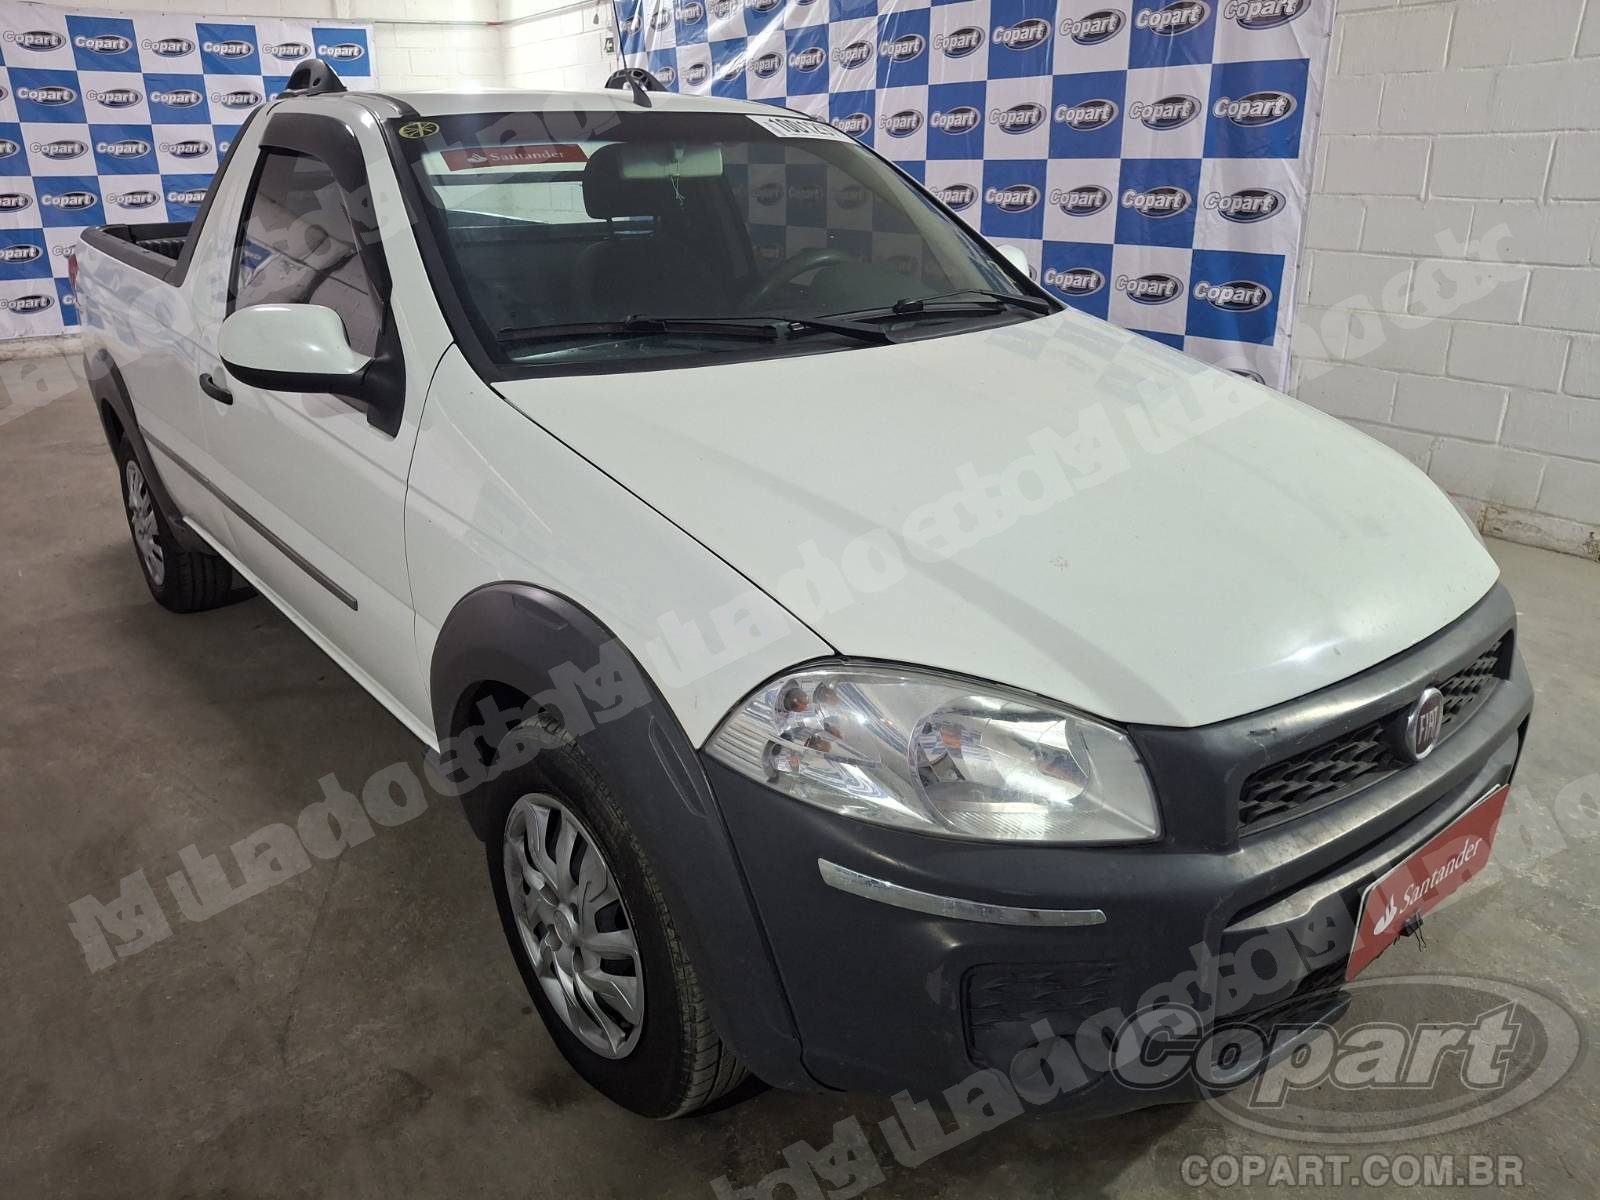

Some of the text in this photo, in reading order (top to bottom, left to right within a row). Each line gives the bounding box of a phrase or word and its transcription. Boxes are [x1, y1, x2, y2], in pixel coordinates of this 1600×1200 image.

[1136, 6, 1200, 31] Copart
[1224, 0, 1297, 22] Copart
[992, 24, 1044, 46] Copart
[1060, 14, 1117, 39] Copart
[3, 31, 59, 46] Copart
[75, 36, 127, 51] Copart
[142, 39, 189, 52] Copart
[934, 30, 980, 52] Copart
[203, 42, 248, 55] Copart
[262, 43, 306, 56] Copart
[318, 45, 359, 57] Copart
[832, 45, 868, 63] Copart
[881, 39, 920, 58] Copart
[789, 53, 822, 69] Copart
[17, 87, 71, 102] Copart
[87, 90, 136, 104] Copart
[151, 91, 199, 104] Copart
[211, 92, 255, 105] Copart
[1054, 104, 1111, 126] Copart
[1129, 101, 1192, 123] Copart
[1213, 96, 1290, 120] Copart
[878, 114, 918, 131] Copart
[931, 110, 976, 130] Copart
[989, 107, 1041, 129] Copart
[30, 142, 80, 156] Copart
[96, 142, 146, 155] Copart
[159, 143, 206, 155] Copart
[489, 150, 565, 162] Santander
[41, 194, 92, 207] Copart
[106, 193, 154, 206] Copart
[985, 189, 1034, 209] Copart
[1050, 189, 1106, 210] Copart
[1121, 190, 1187, 212] Copart
[1203, 192, 1273, 216] Copart
[1044, 268, 1100, 290] Copart
[1114, 274, 1177, 297] Copart
[1194, 281, 1262, 305] Copart
[1417, 705, 1440, 743] FIAT
[1399, 837, 1483, 914] Santander
